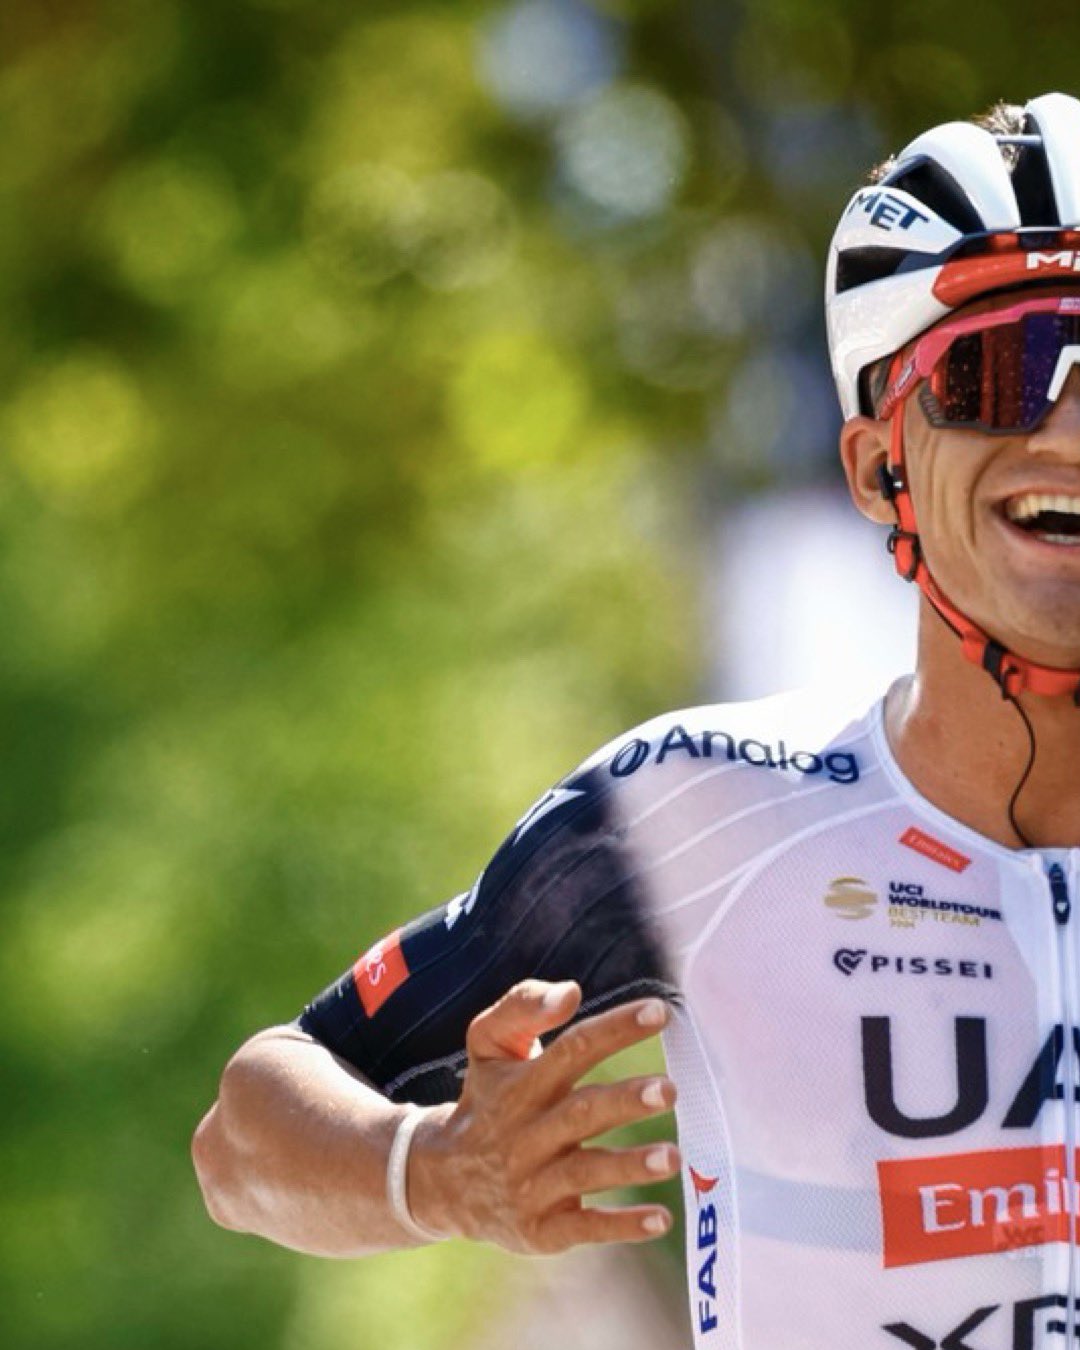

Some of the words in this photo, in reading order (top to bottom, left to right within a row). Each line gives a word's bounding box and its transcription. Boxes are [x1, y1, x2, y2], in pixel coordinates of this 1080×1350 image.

[848, 192, 930, 231] MET
[655, 724, 859, 783] Analog
[889, 881, 924, 896] UCI
[888, 894, 1002, 921] WORLDTOUR
[871, 955, 993, 979] PISSEI
[697, 1202, 718, 1335] FAB
